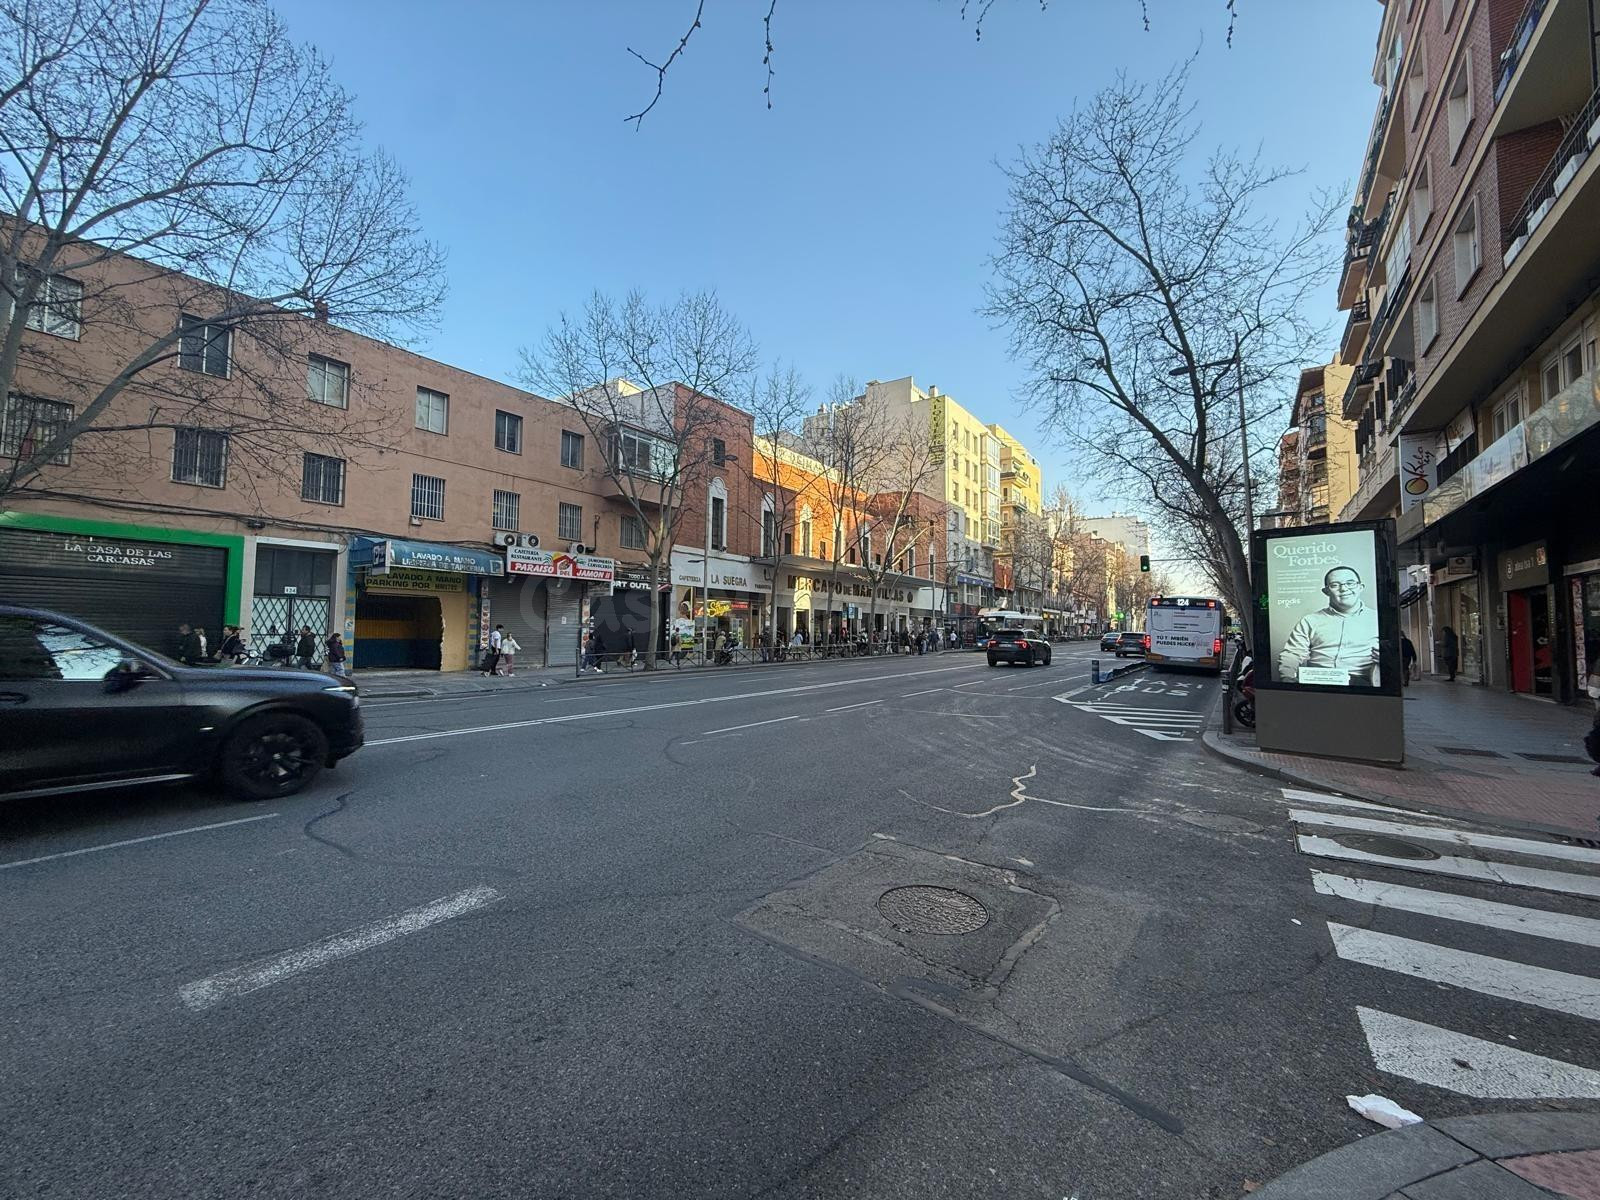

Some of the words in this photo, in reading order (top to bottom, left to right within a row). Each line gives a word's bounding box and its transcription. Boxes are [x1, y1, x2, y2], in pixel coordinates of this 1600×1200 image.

[64, 543, 82, 551] LA
[87, 545, 122, 555] CASA
[126, 548, 144, 557] DE
[148, 550, 172, 559] LAS
[411, 551, 442, 562] LAVADO
[1273, 542, 1336, 559] Querido
[87, 554, 155, 566] CARCASAS
[515, 562, 555, 574] PARAISO
[386, 572, 424, 582] LAVADO
[711, 574, 719, 585] LA
[723, 576, 747, 587] SUEGRA
[366, 579, 409, 589] PARKING
[412, 581, 430, 589] POR
[630, 582, 651, 590] OUTL
[852, 583, 904, 602] MARVILLAS
[1177, 599, 1189, 607] 124
